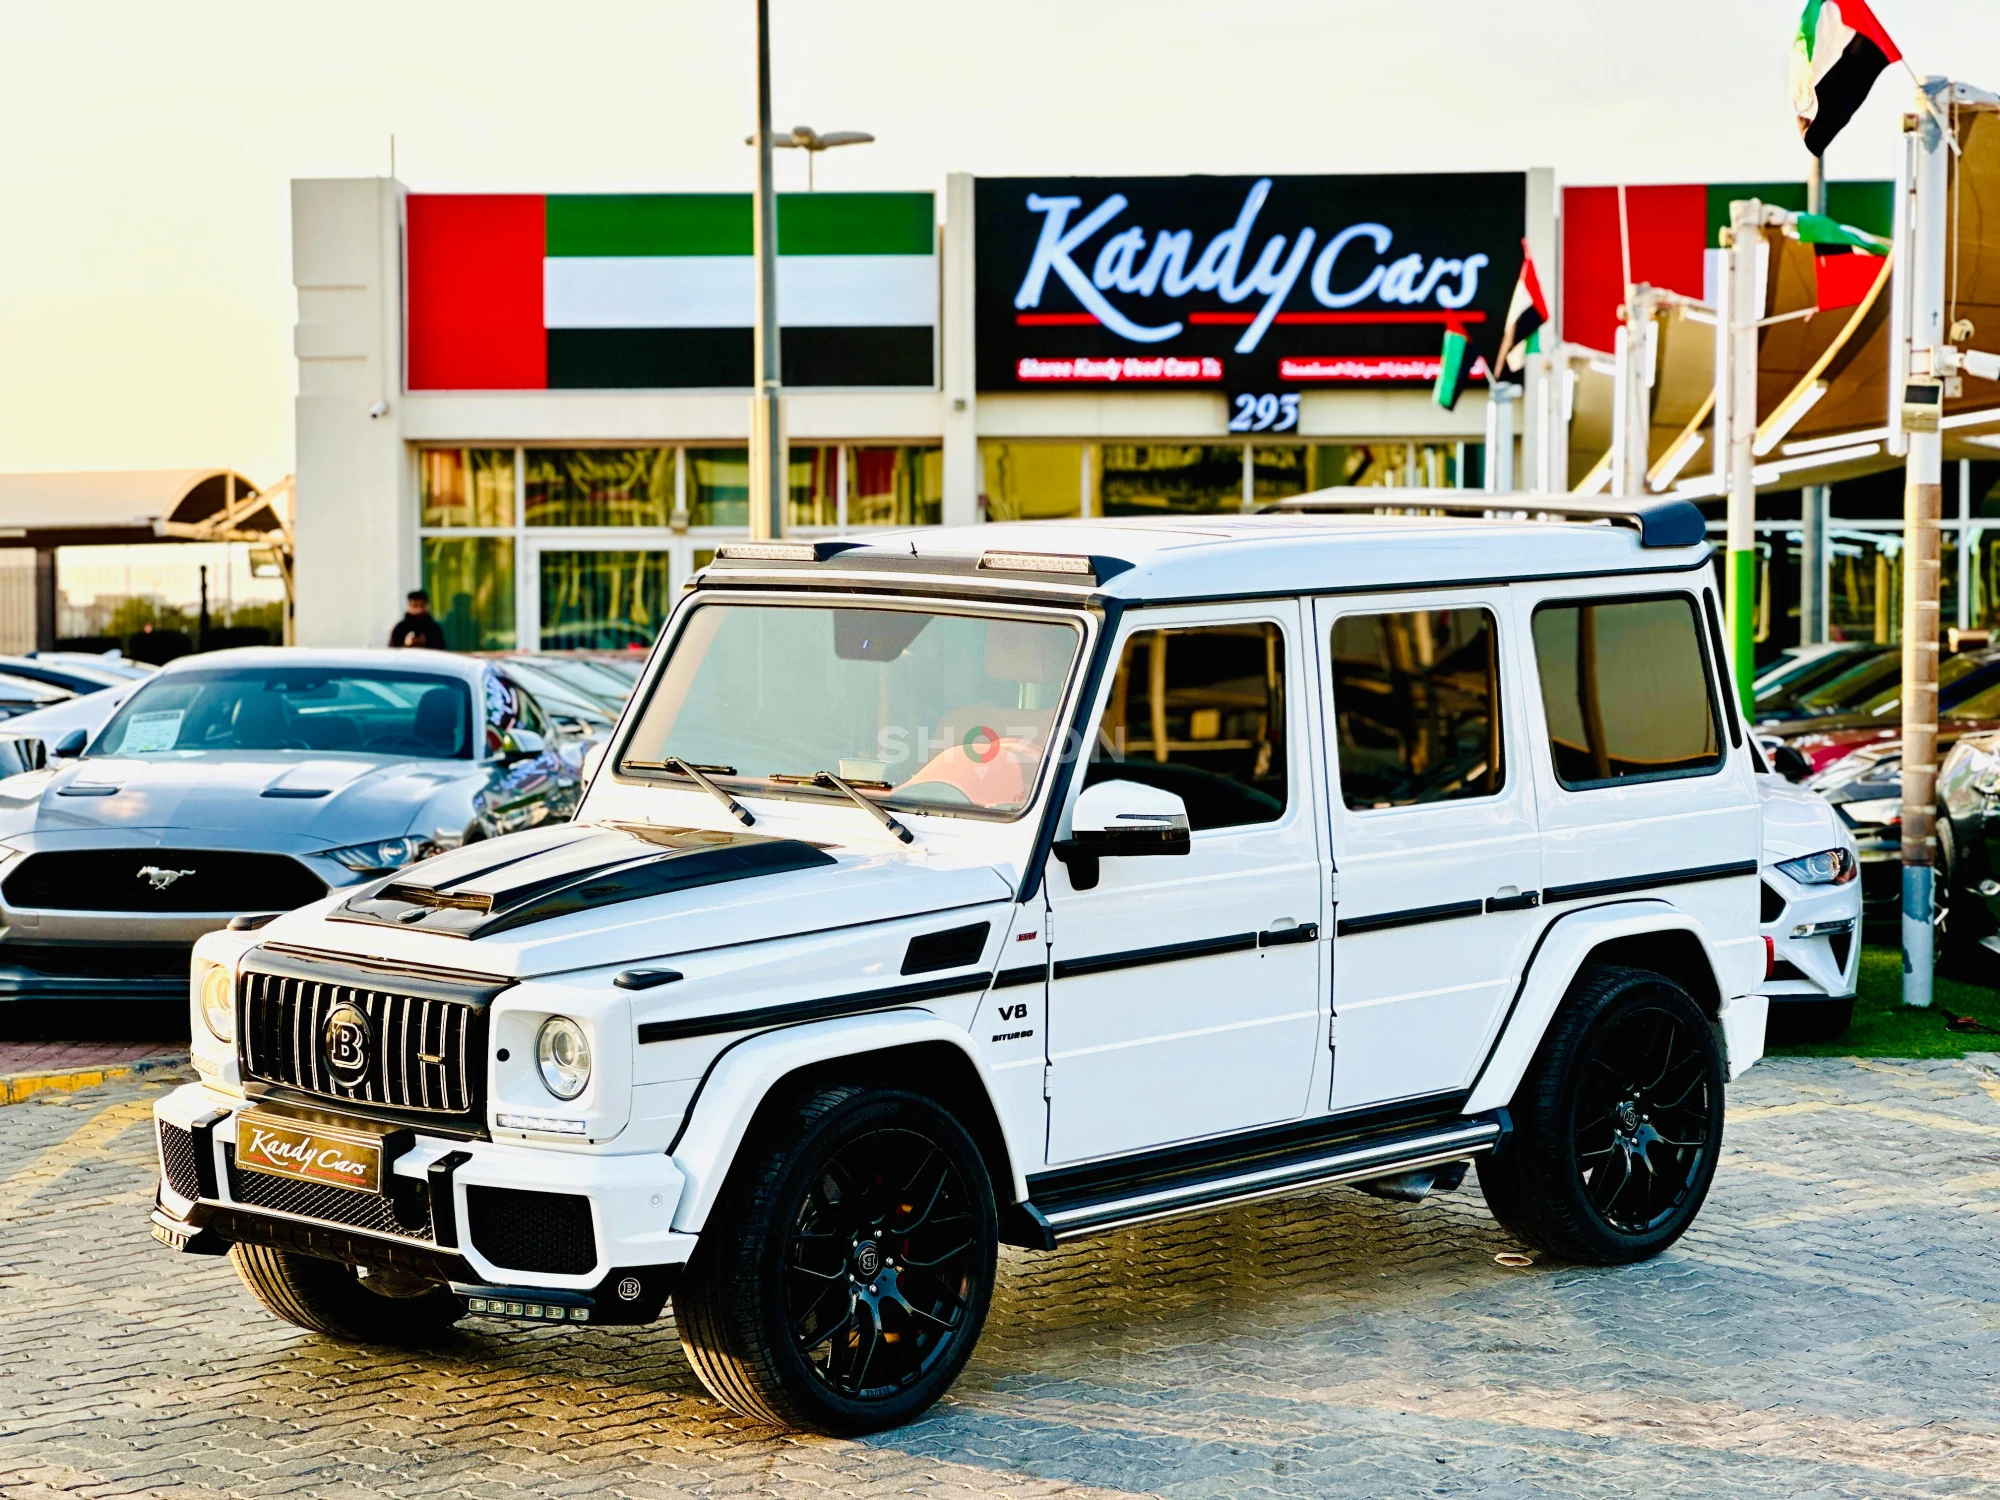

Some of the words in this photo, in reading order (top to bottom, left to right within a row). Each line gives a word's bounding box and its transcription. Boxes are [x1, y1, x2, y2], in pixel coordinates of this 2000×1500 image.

[1014, 178, 1317, 354] Kandy
[1311, 222, 1490, 309] Cars
[998, 1003, 1027, 1021] V8
[992, 1030, 1033, 1042] BITURBO
[249, 1128, 318, 1173] Kandy
[317, 1149, 367, 1175] Cars
